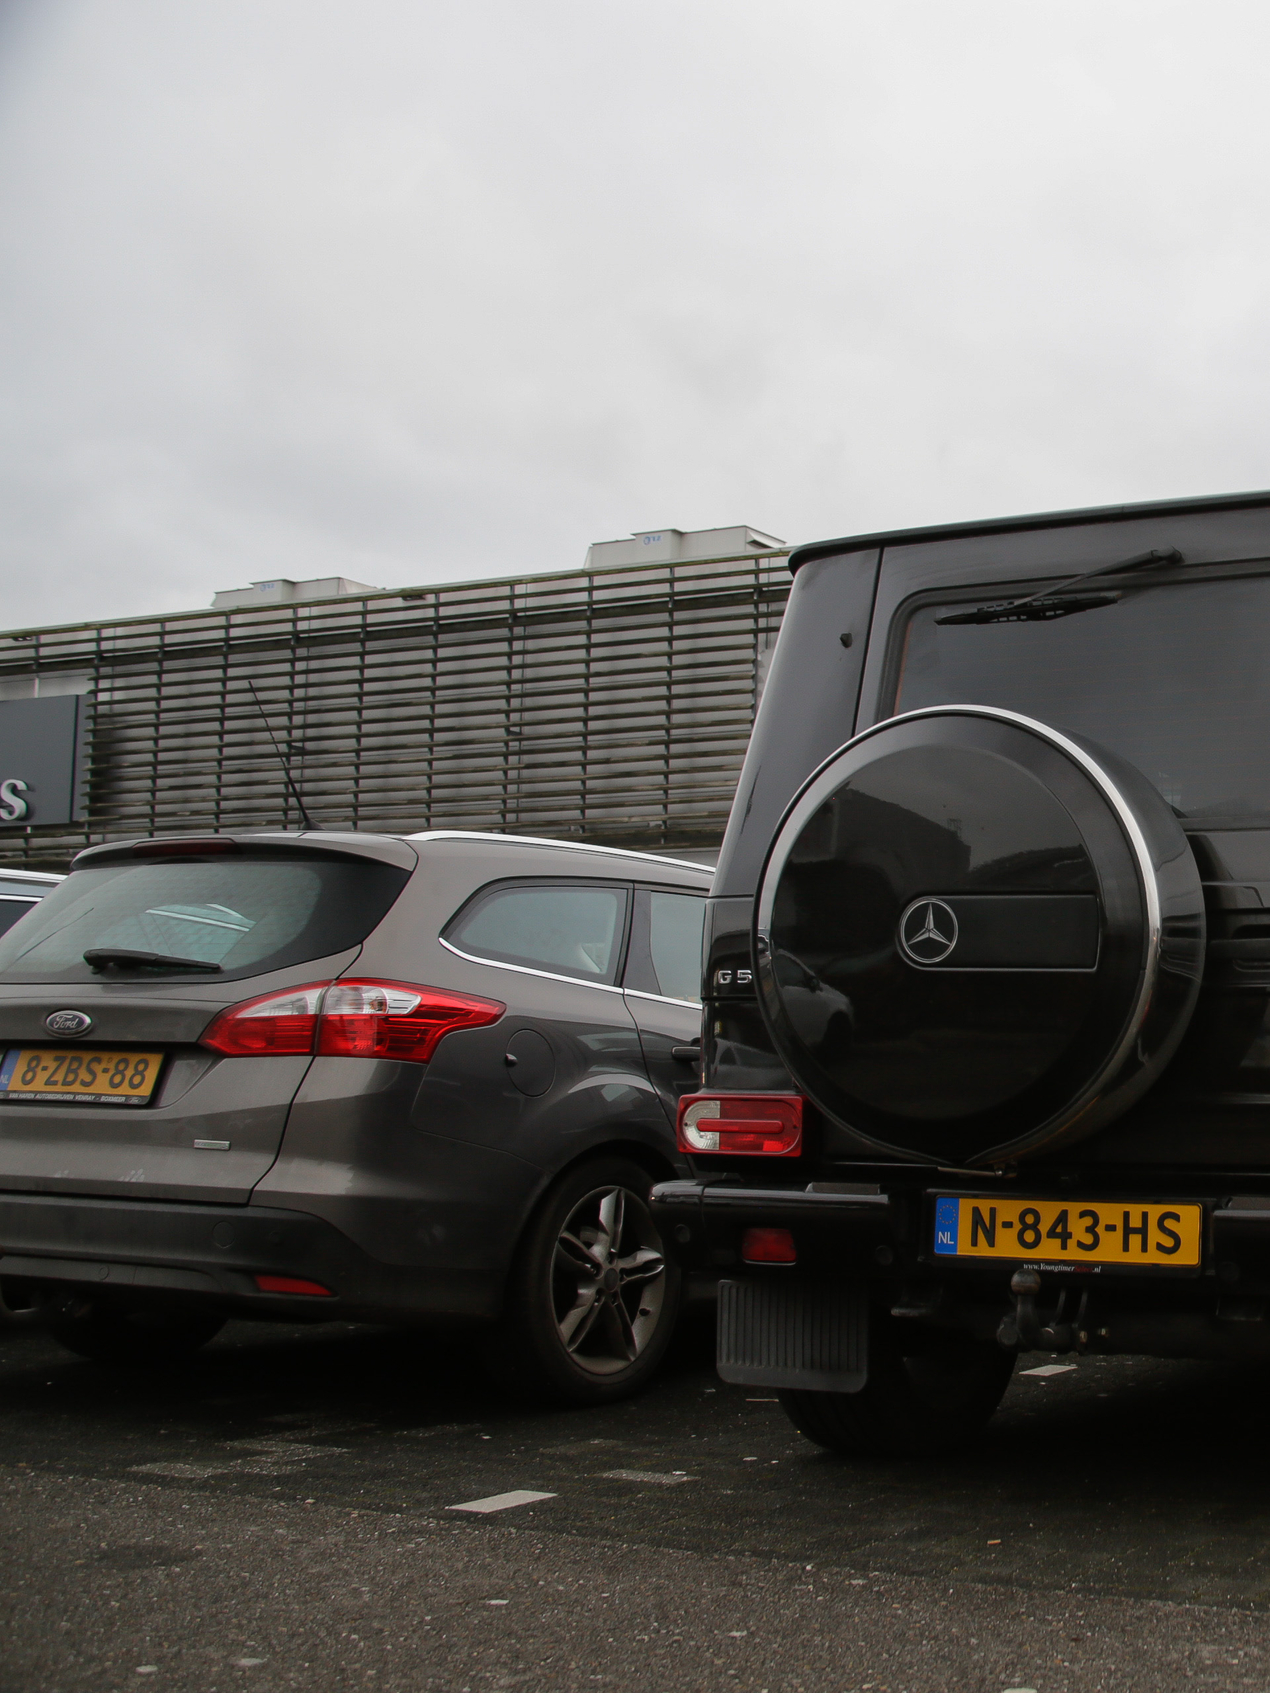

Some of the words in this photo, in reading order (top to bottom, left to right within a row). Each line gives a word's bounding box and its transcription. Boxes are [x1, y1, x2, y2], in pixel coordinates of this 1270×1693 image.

[718, 970, 732, 984] G
[737, 969, 753, 984] 5
[53, 1014, 80, 1029] Ford
[21, 1055, 150, 1090] 8-ZBS-88
[938, 1231, 954, 1245] NL
[970, 1206, 1182, 1255] N-843-HS
